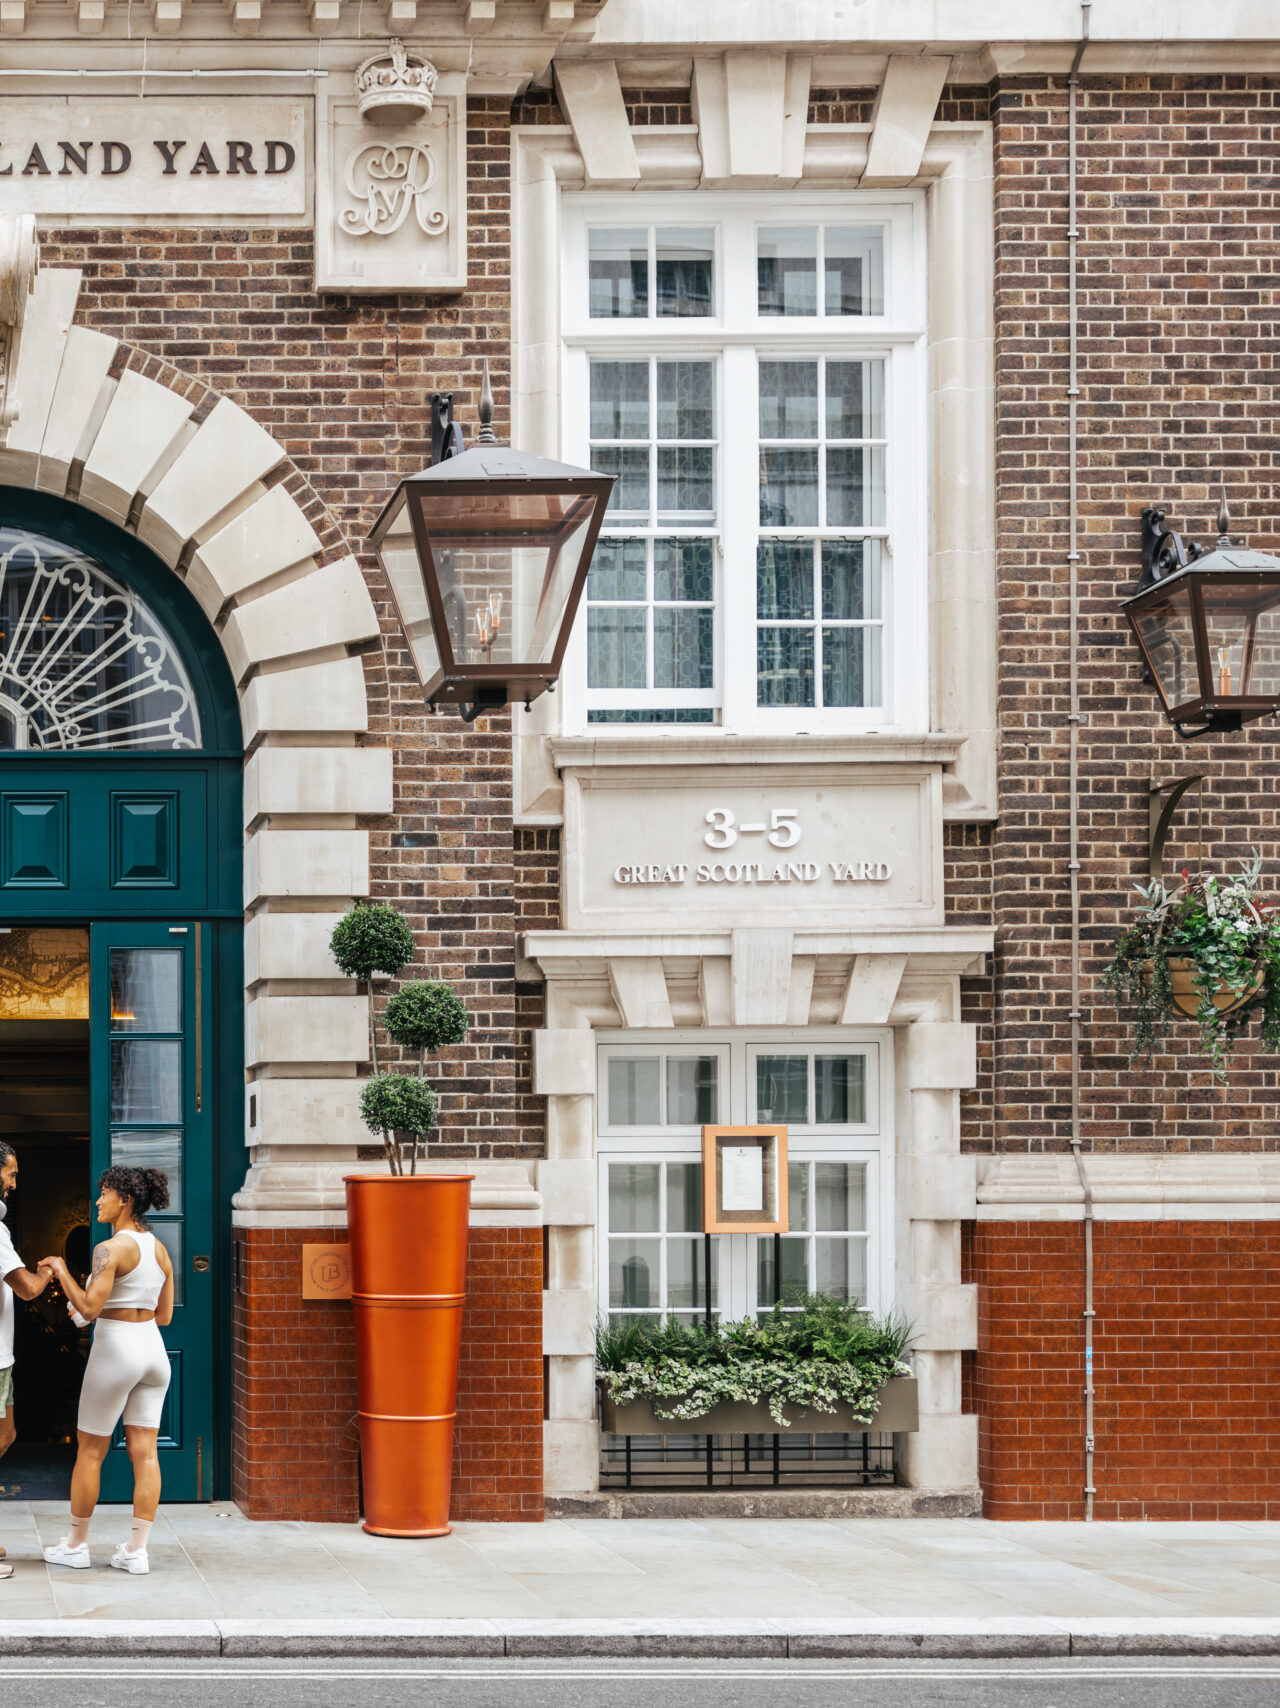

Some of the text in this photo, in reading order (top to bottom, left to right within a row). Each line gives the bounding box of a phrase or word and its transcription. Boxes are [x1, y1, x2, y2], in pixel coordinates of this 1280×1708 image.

[153, 140, 296, 175] YARD
[613, 861, 893, 884] GREAT SCOTLAND YARD
